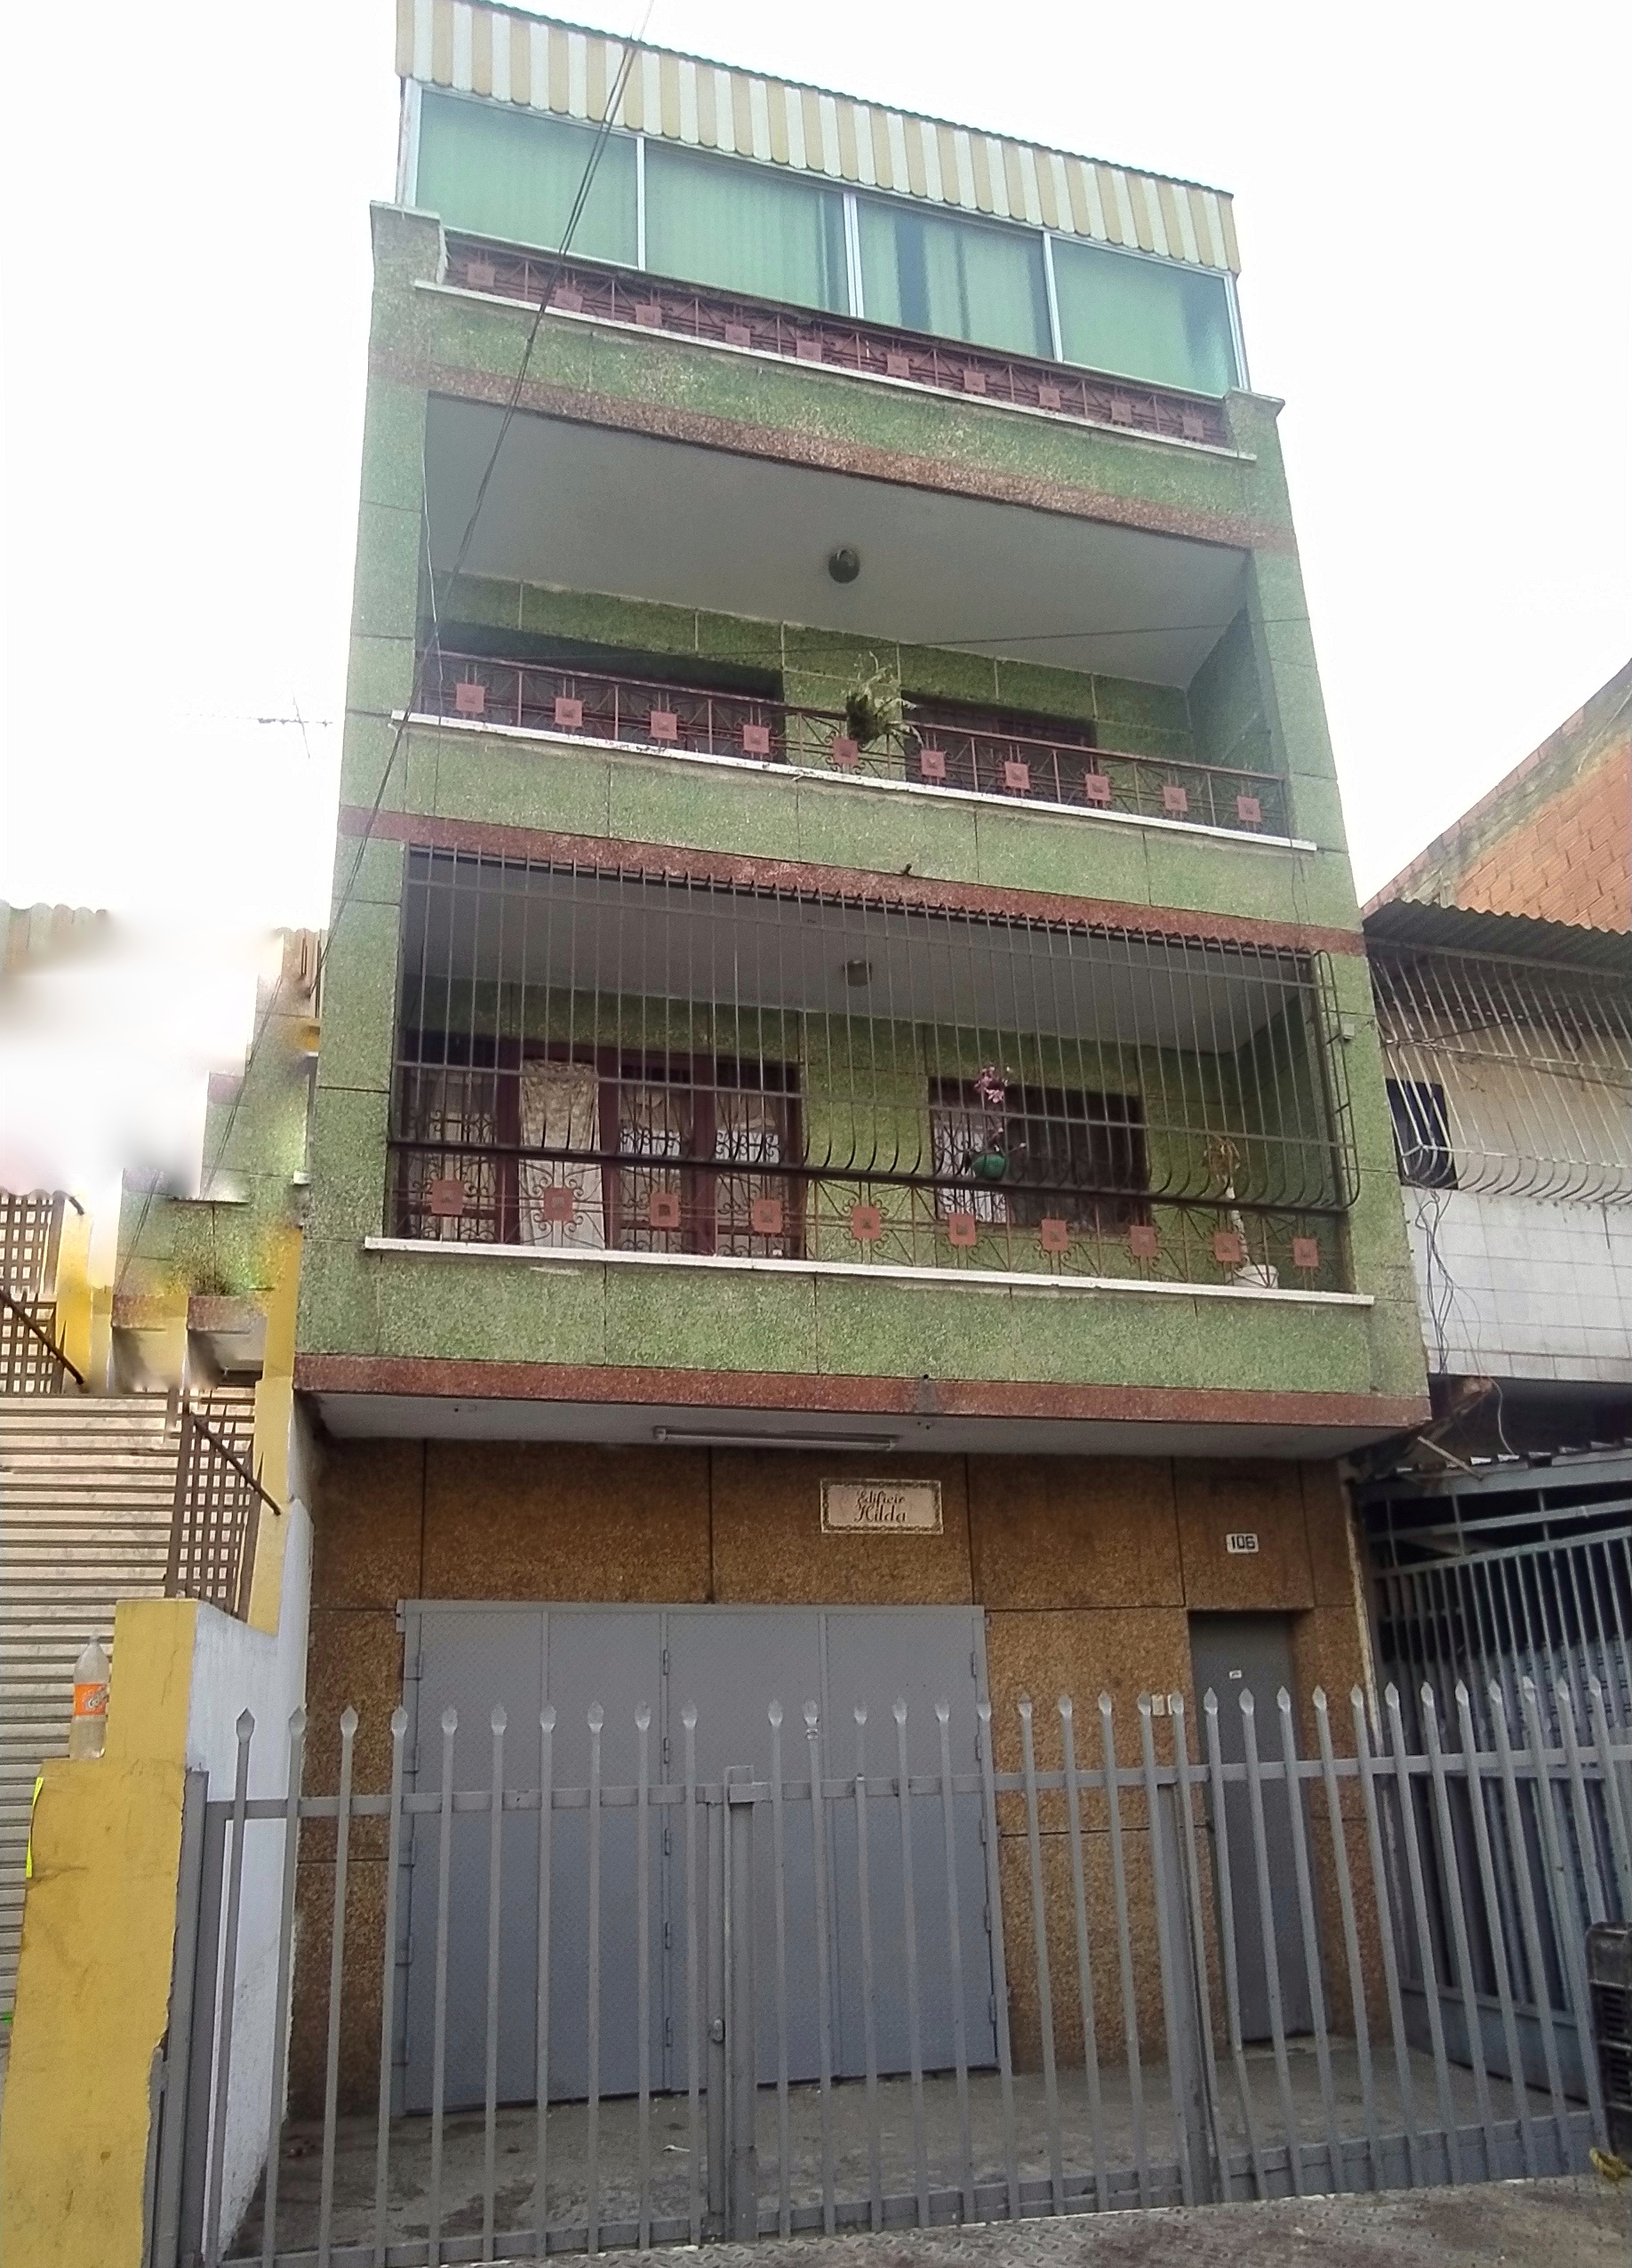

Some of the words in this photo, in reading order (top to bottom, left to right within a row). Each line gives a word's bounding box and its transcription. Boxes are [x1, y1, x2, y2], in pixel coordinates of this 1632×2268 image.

[856, 1489, 906, 1507] Edificio
[853, 1503, 907, 1523] Hilda
[1231, 1535, 1255, 1550] 106
